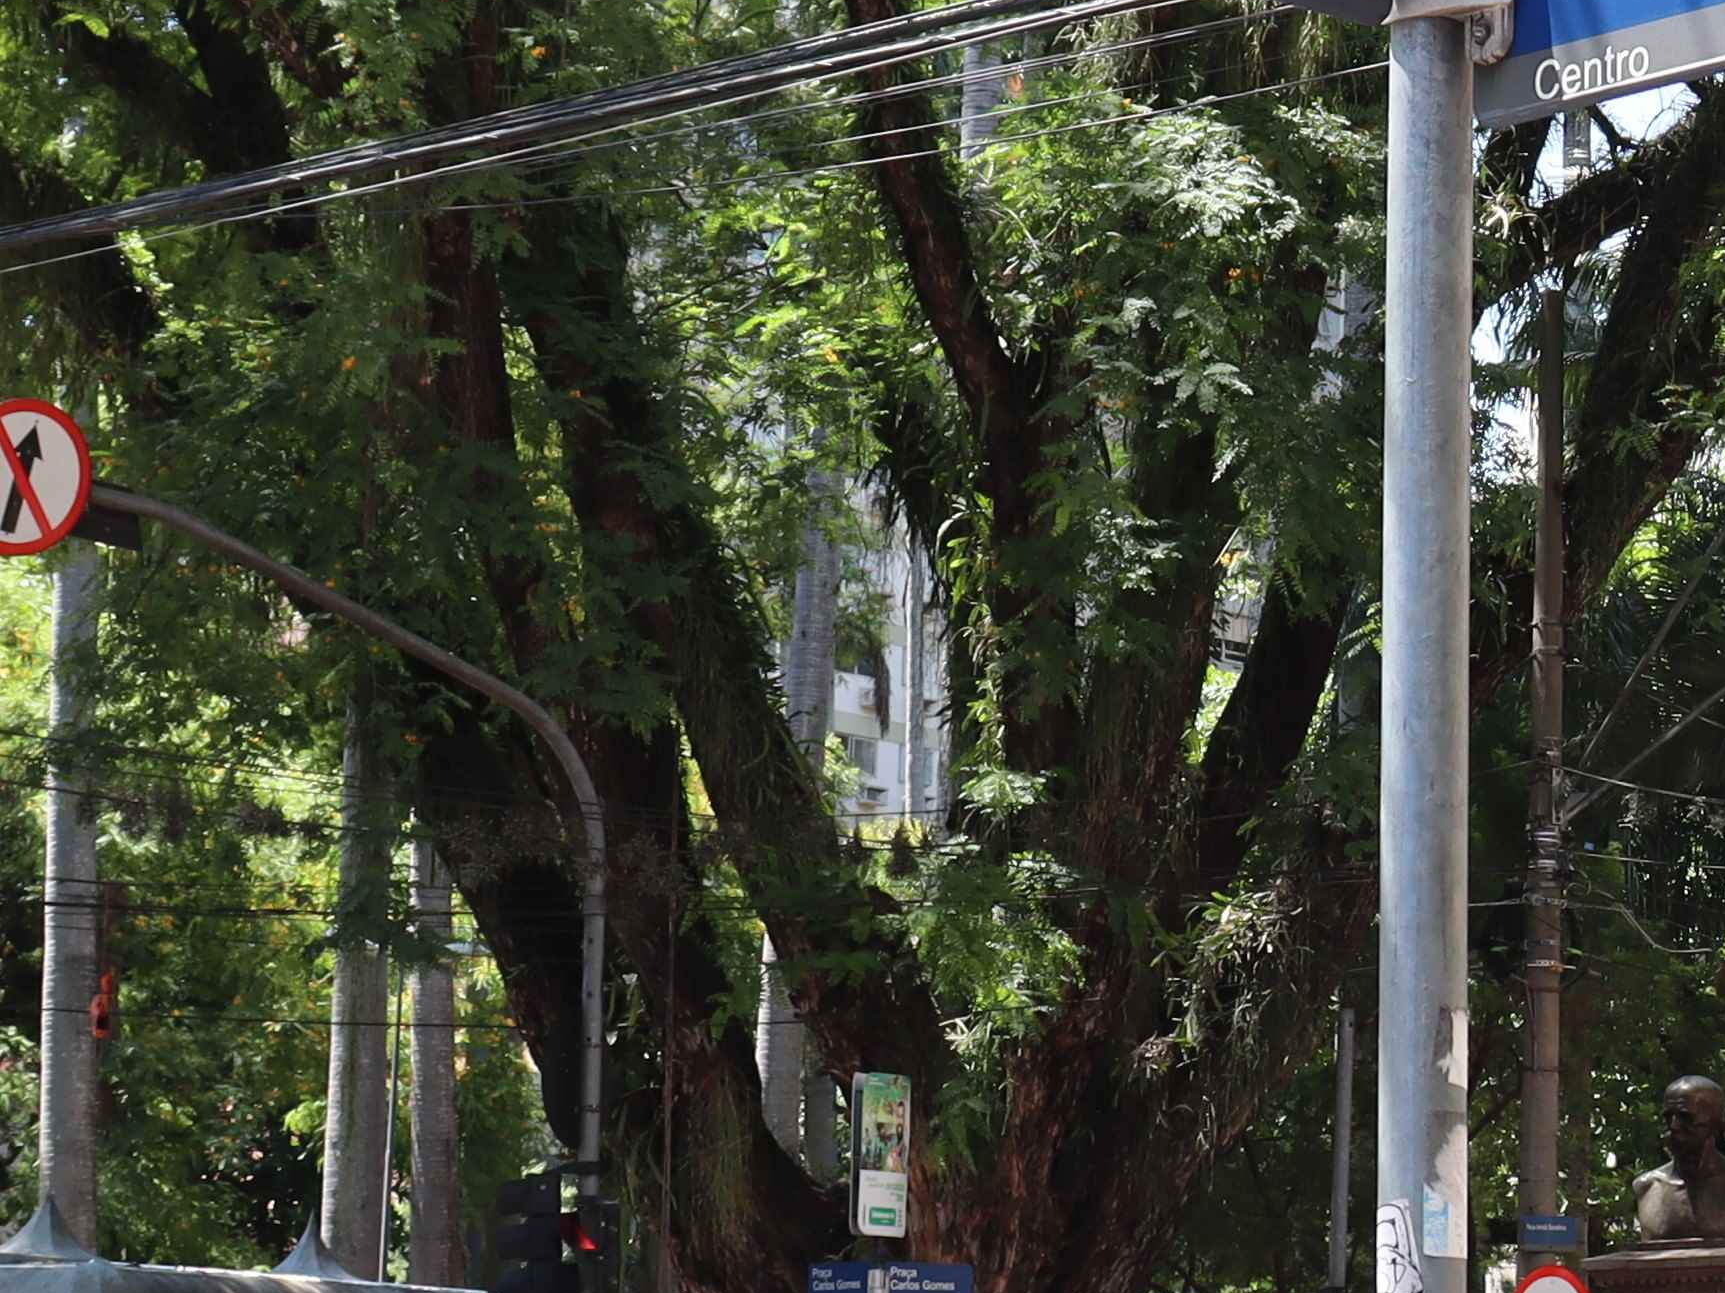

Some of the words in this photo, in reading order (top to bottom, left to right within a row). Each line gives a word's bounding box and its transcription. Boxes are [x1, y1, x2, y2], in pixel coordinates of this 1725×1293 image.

[1535, 41, 1650, 101] Centro
[890, 1266, 917, 1281] Praça
[812, 1280, 835, 1291] Carlos
[836, 1279, 861, 1290] Gomes
[890, 1279, 920, 1291] Carlos
[922, 1279, 955, 1291] Gomes
